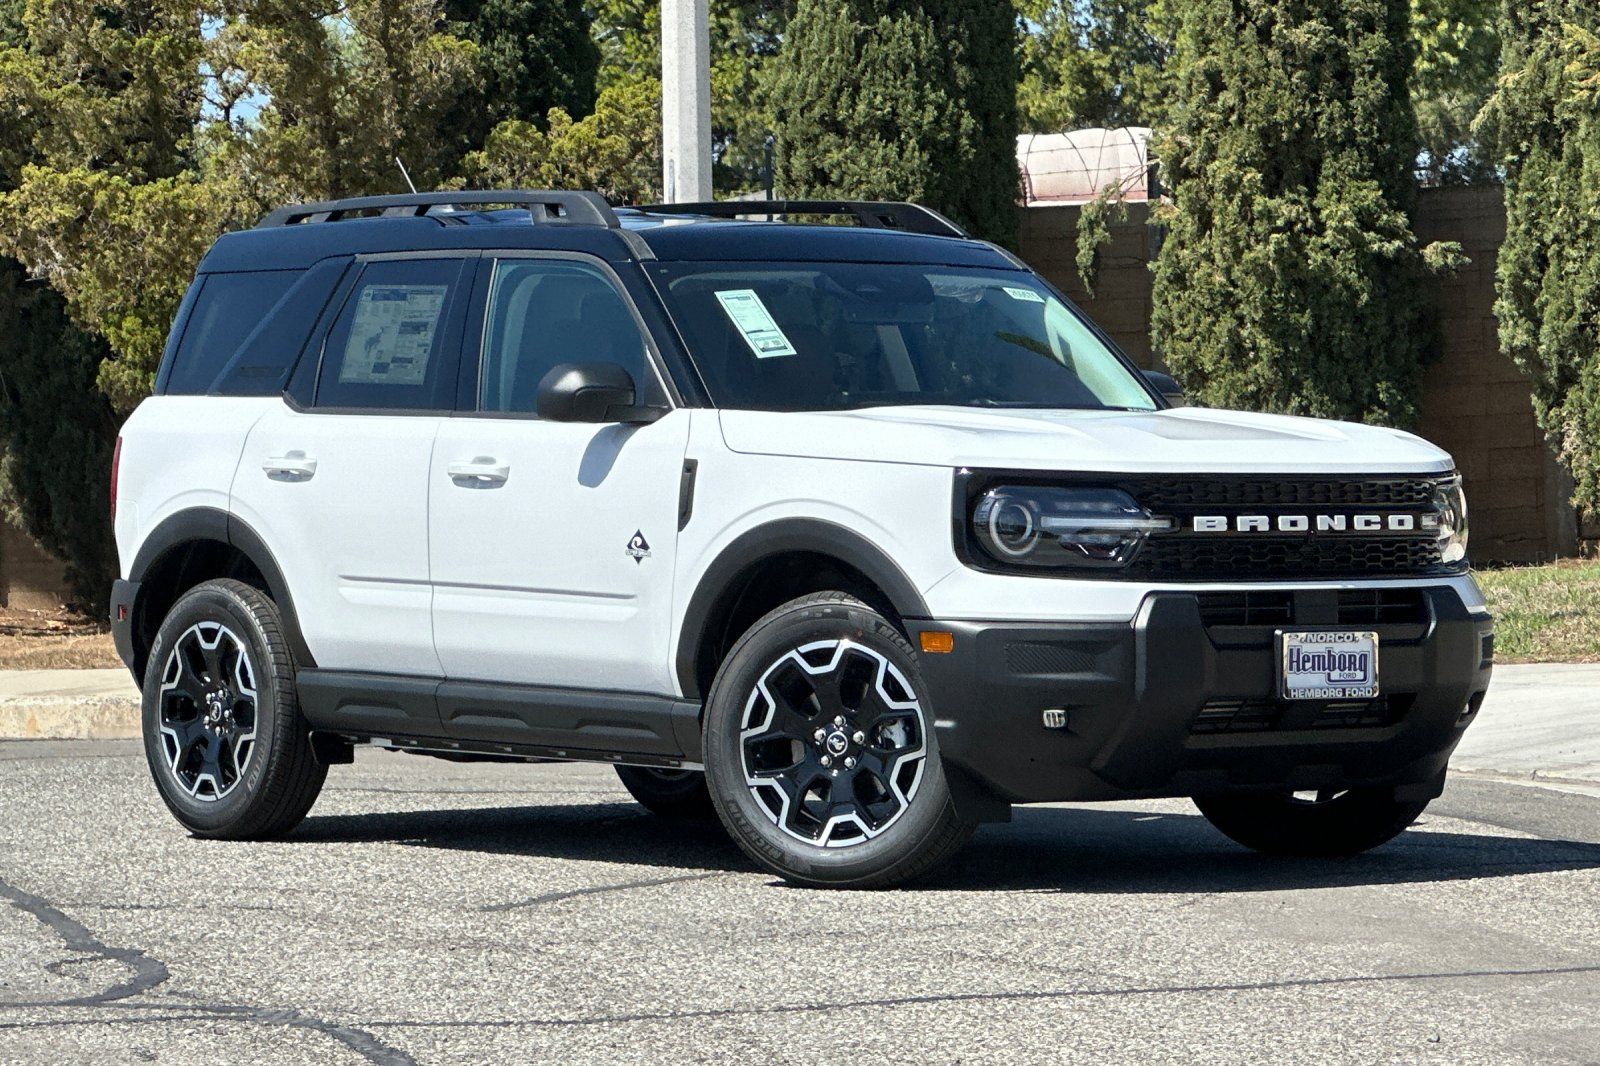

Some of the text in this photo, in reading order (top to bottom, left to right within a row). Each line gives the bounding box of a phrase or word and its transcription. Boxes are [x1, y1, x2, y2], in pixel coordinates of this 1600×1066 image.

[1193, 515, 1414, 532] BRONCO
[1306, 632, 1356, 644] NORCO
[1338, 672, 1357, 680] FORD
[1290, 687, 1373, 699] HEMBORG FORD
